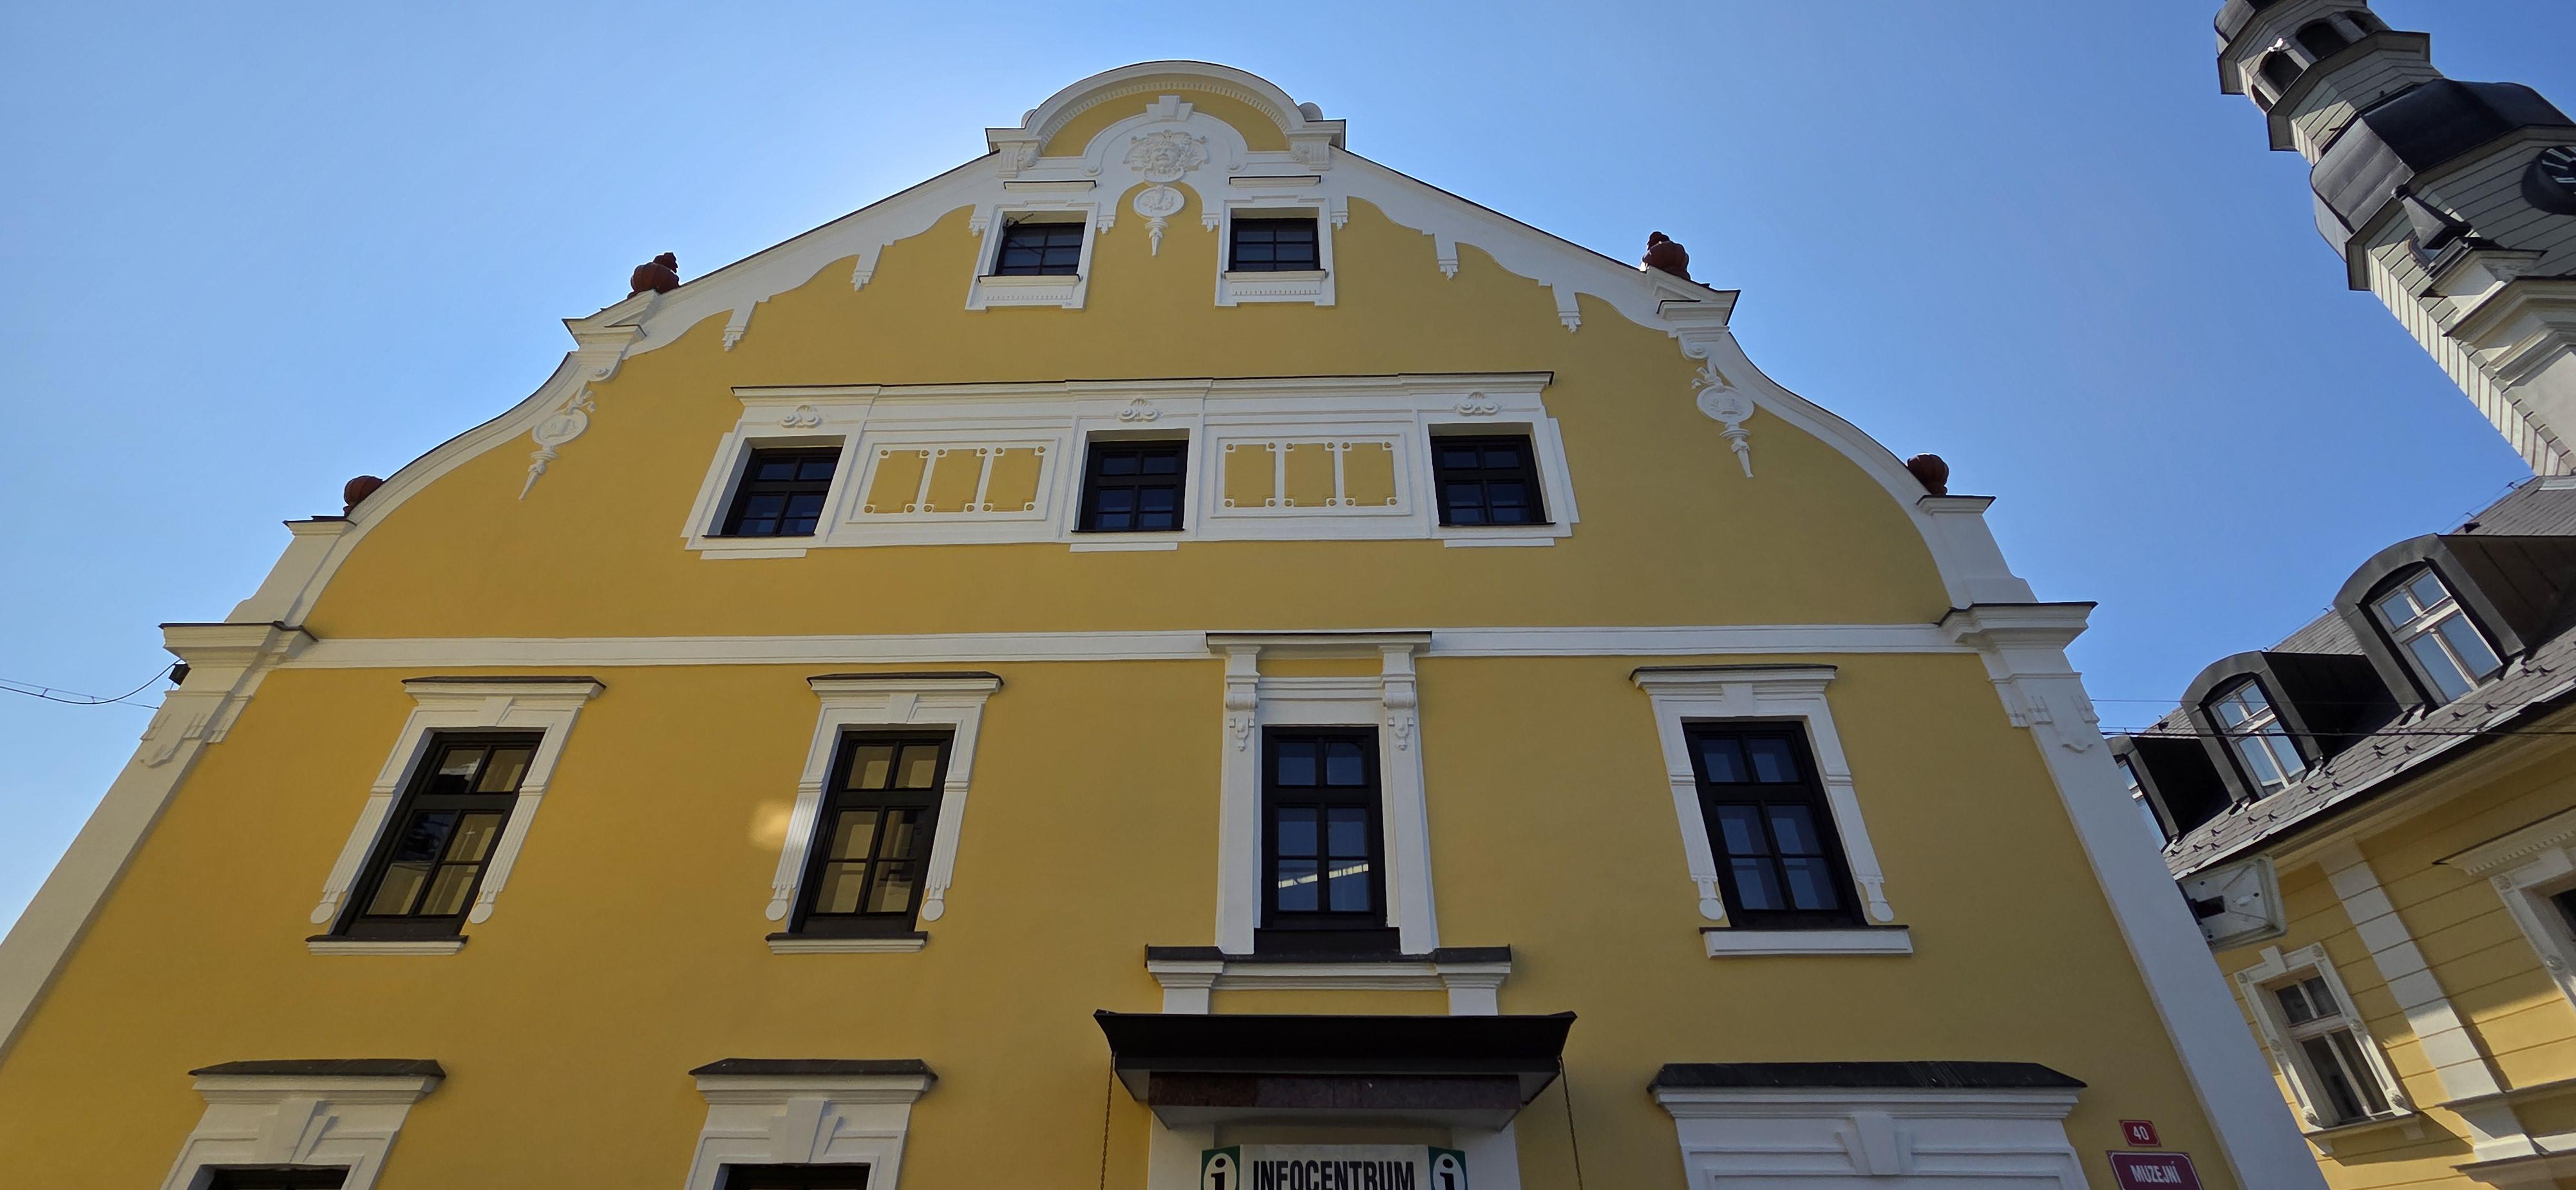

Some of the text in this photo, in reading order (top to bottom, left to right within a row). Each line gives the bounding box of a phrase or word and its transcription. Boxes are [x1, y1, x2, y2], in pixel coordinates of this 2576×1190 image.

[2133, 1126, 2149, 1140] 40
[1253, 1160, 1416, 1190] INFOCENTRUM
[2130, 1160, 2182, 1184] MUZEJNÍ
